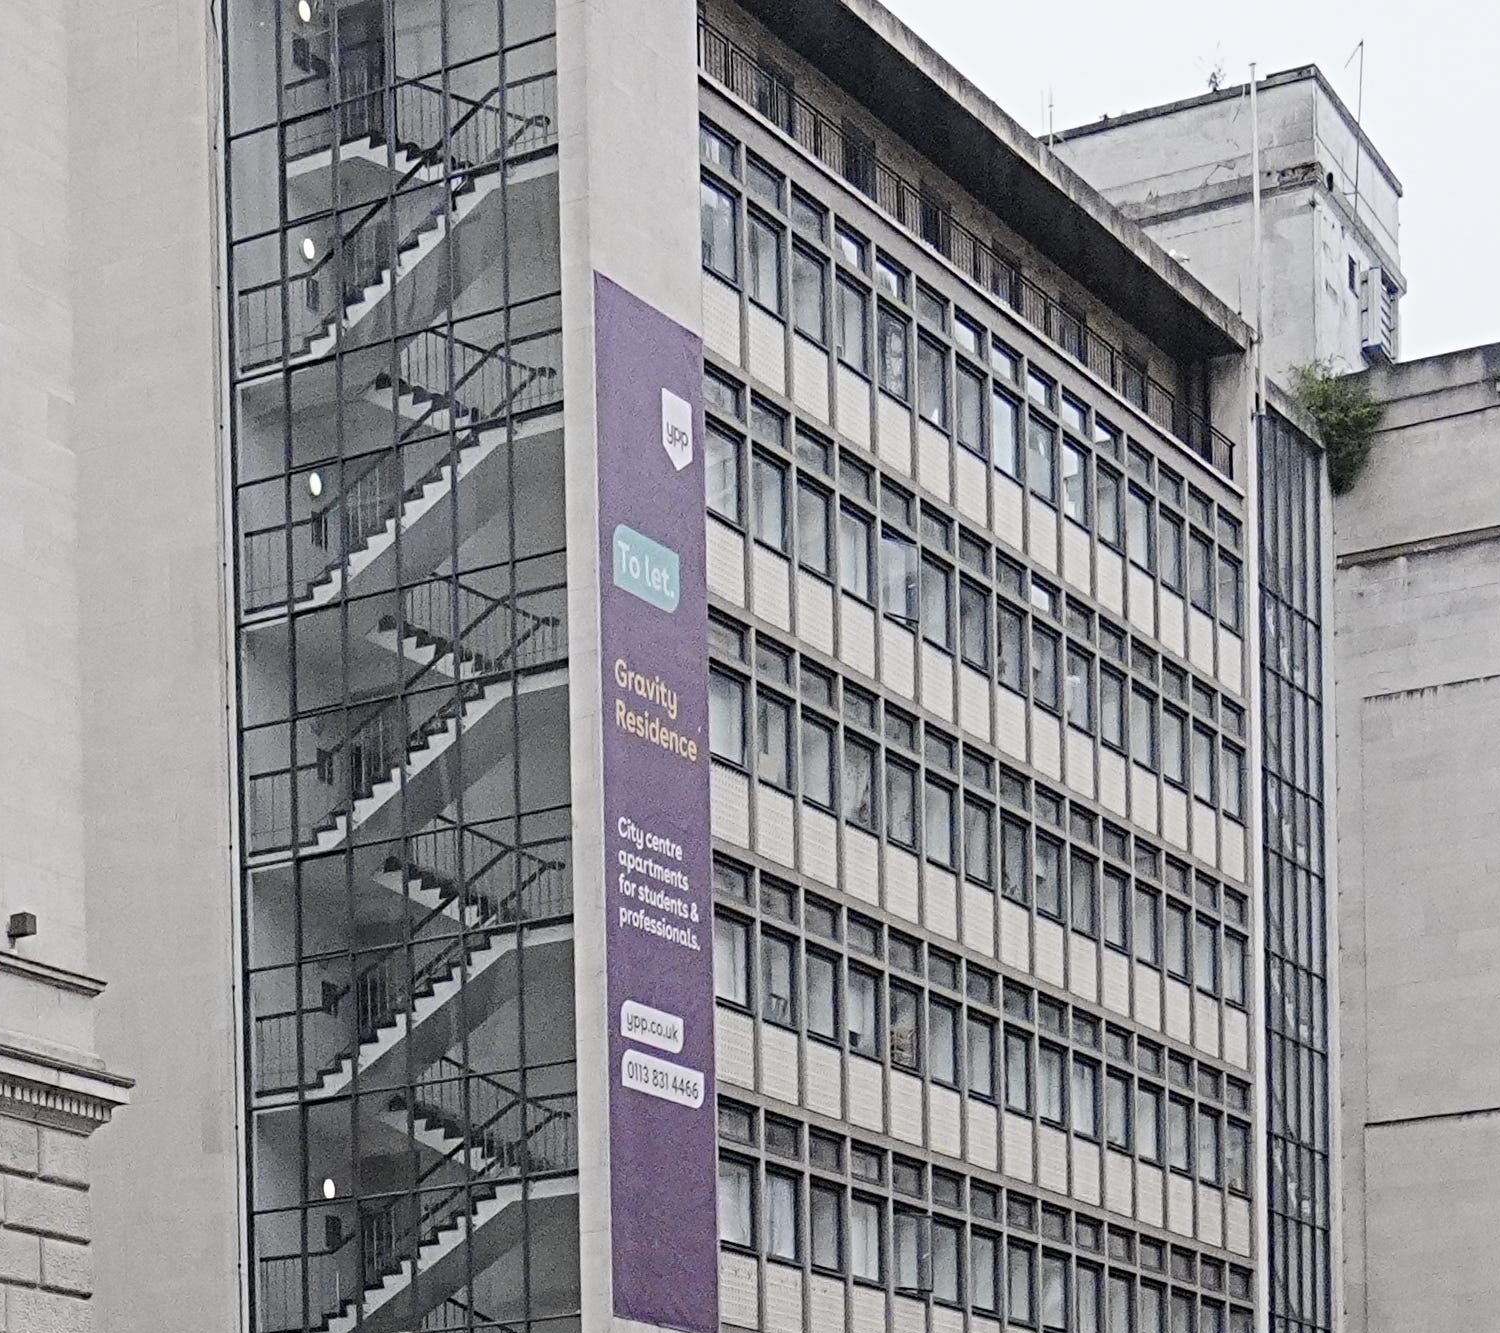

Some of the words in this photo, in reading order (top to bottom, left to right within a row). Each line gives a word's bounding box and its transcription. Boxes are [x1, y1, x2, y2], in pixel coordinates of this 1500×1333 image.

[665, 420, 690, 449] ypp
[618, 541, 641, 580] To
[646, 555, 676, 598] let.
[614, 658, 678, 720] Gravity
[615, 698, 698, 762] Residence
[617, 816, 644, 850] City
[645, 832, 683, 861] centre
[618, 849, 689, 891] apartments
[618, 873, 637, 898] for
[638, 885, 689, 919] students
[690, 902, 699, 922] &
[619, 906, 701, 951] professionals.
[626, 1011, 680, 1043] ypp.co.uk
[626, 1059, 651, 1086] 0113
[651, 1068, 670, 1092] 831
[671, 1075, 699, 1101] 4466
